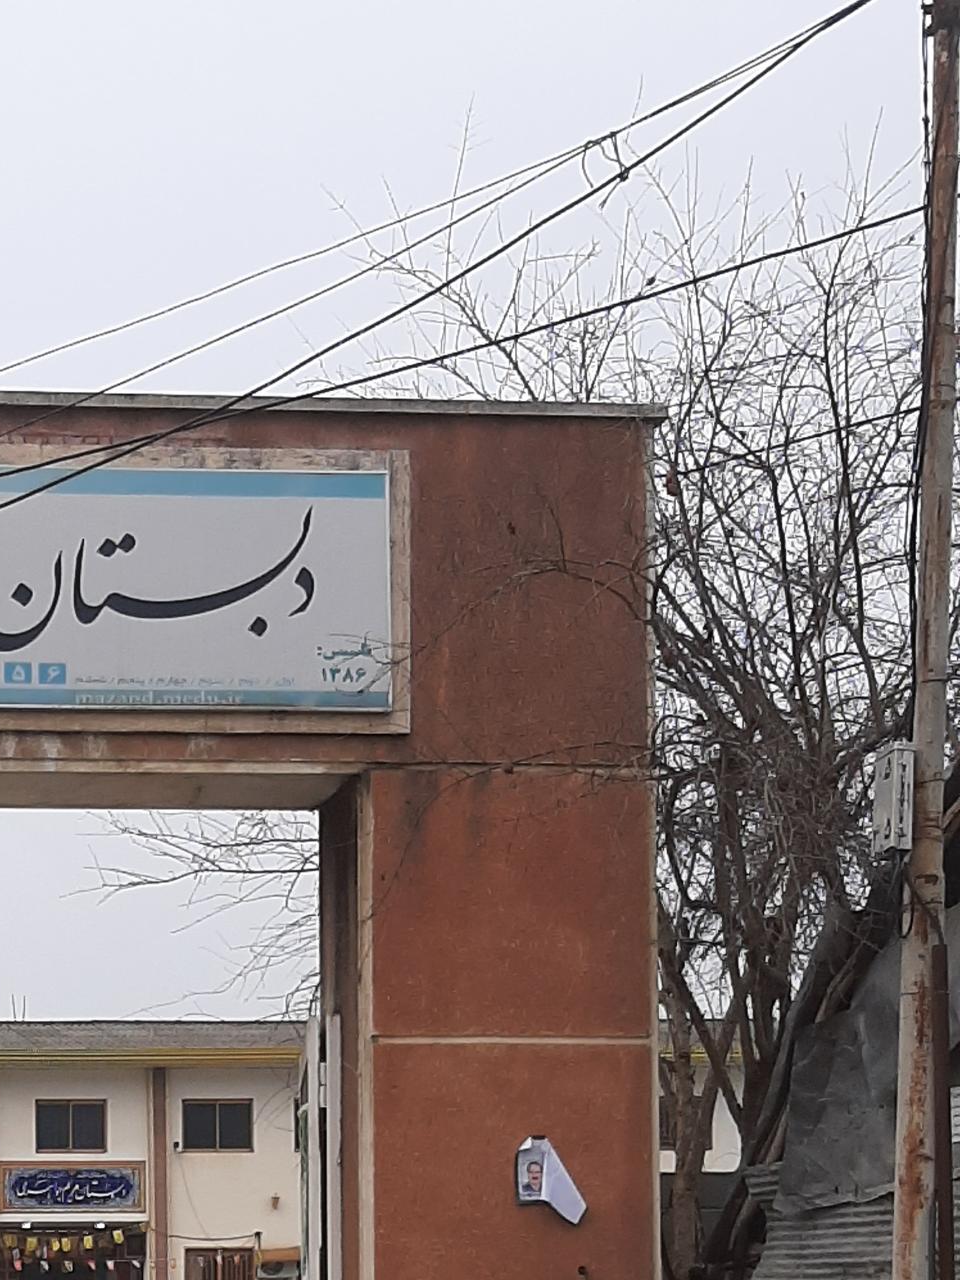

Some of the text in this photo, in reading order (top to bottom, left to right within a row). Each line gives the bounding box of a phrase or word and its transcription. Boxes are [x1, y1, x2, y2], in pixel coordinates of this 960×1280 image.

[11, 664, 26, 681] ۵
[46, 666, 61, 682] ۶
[321, 667, 367, 682] ۱۳۸۶
